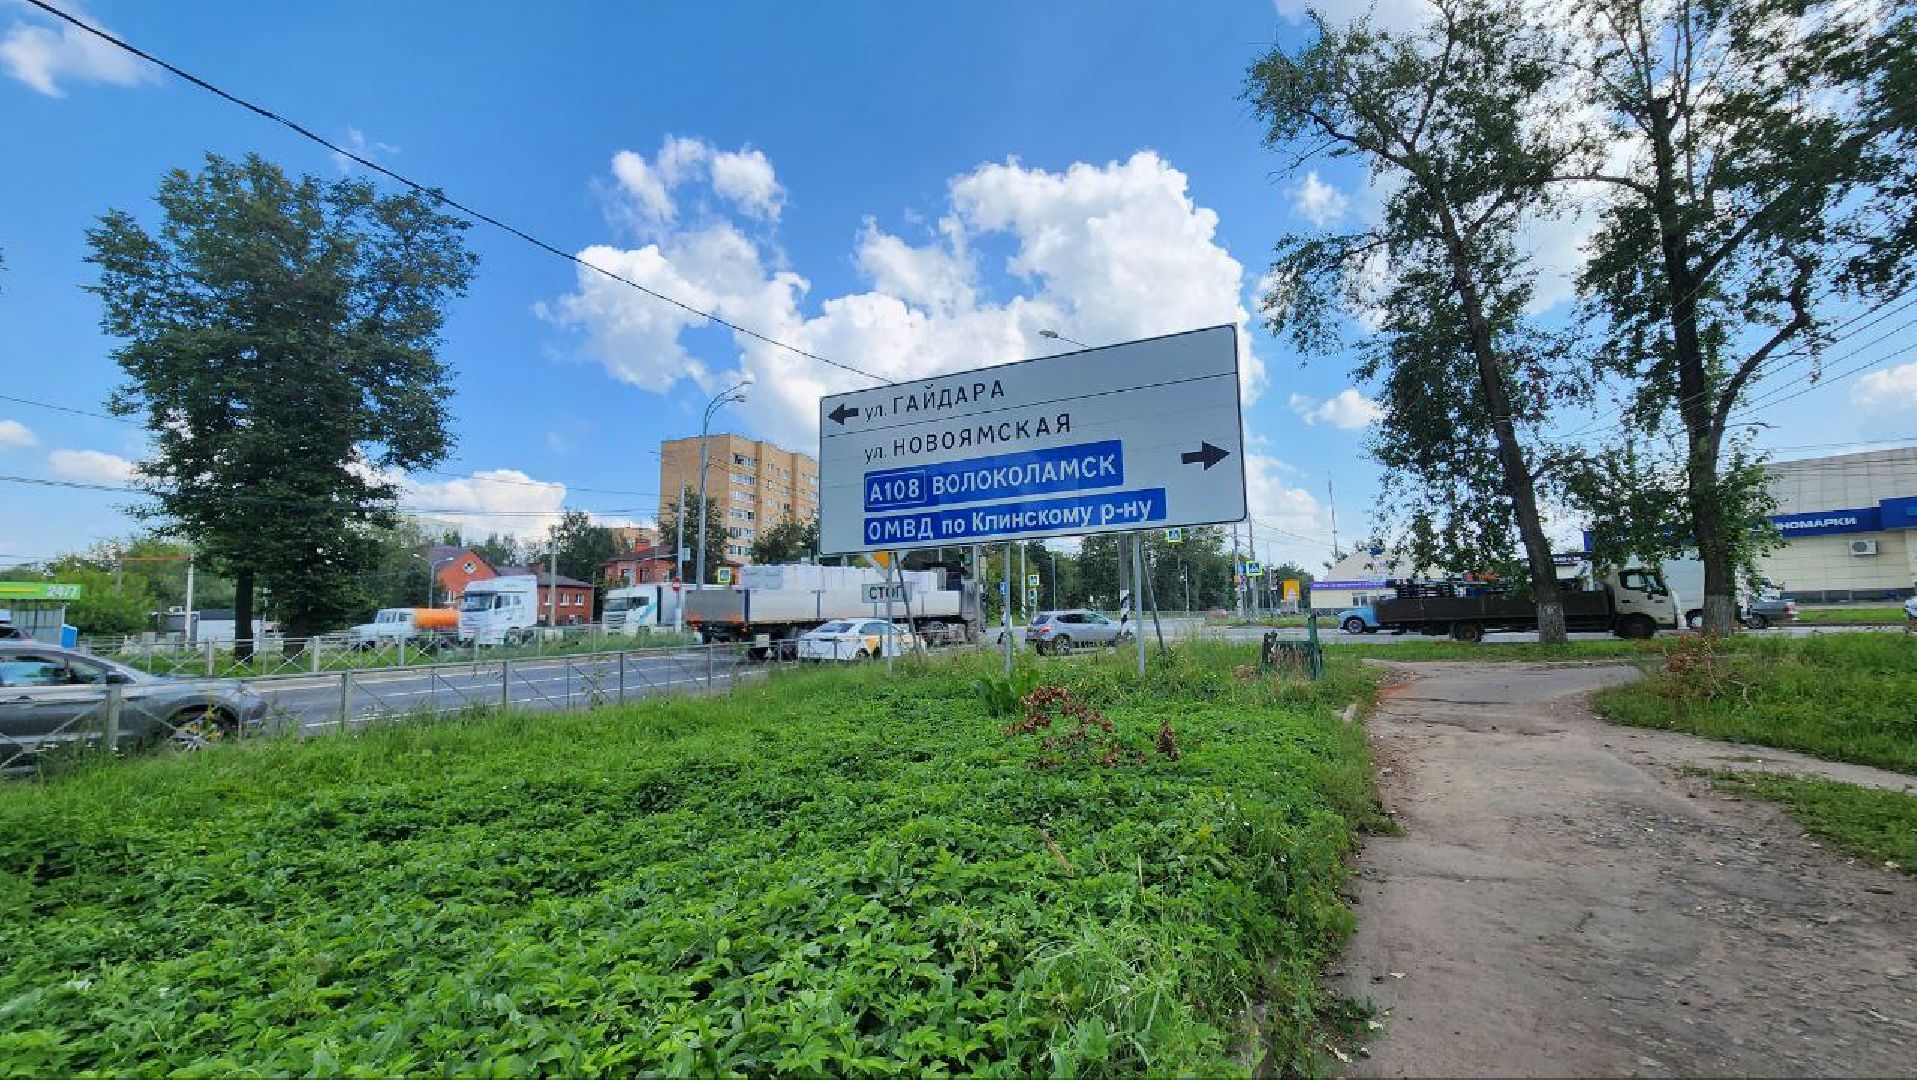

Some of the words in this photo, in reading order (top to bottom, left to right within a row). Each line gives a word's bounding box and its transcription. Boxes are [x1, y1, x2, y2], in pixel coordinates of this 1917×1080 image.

[865, 404, 887, 420] ул.
[893, 379, 1005, 414] ГАЙДАРА
[865, 446, 887, 464] ул.
[893, 413, 1072, 457] НОВОЯМСКАЯ
[869, 475, 920, 502] А108
[932, 454, 1116, 496] ВОЛОКОЛАМСК
[868, 517, 934, 541] ОМВД
[942, 517, 965, 535] по
[972, 504, 1093, 532] Клинскому
[1100, 498, 1152, 526] р-ну
[47, 584, 78, 598] 24/7
